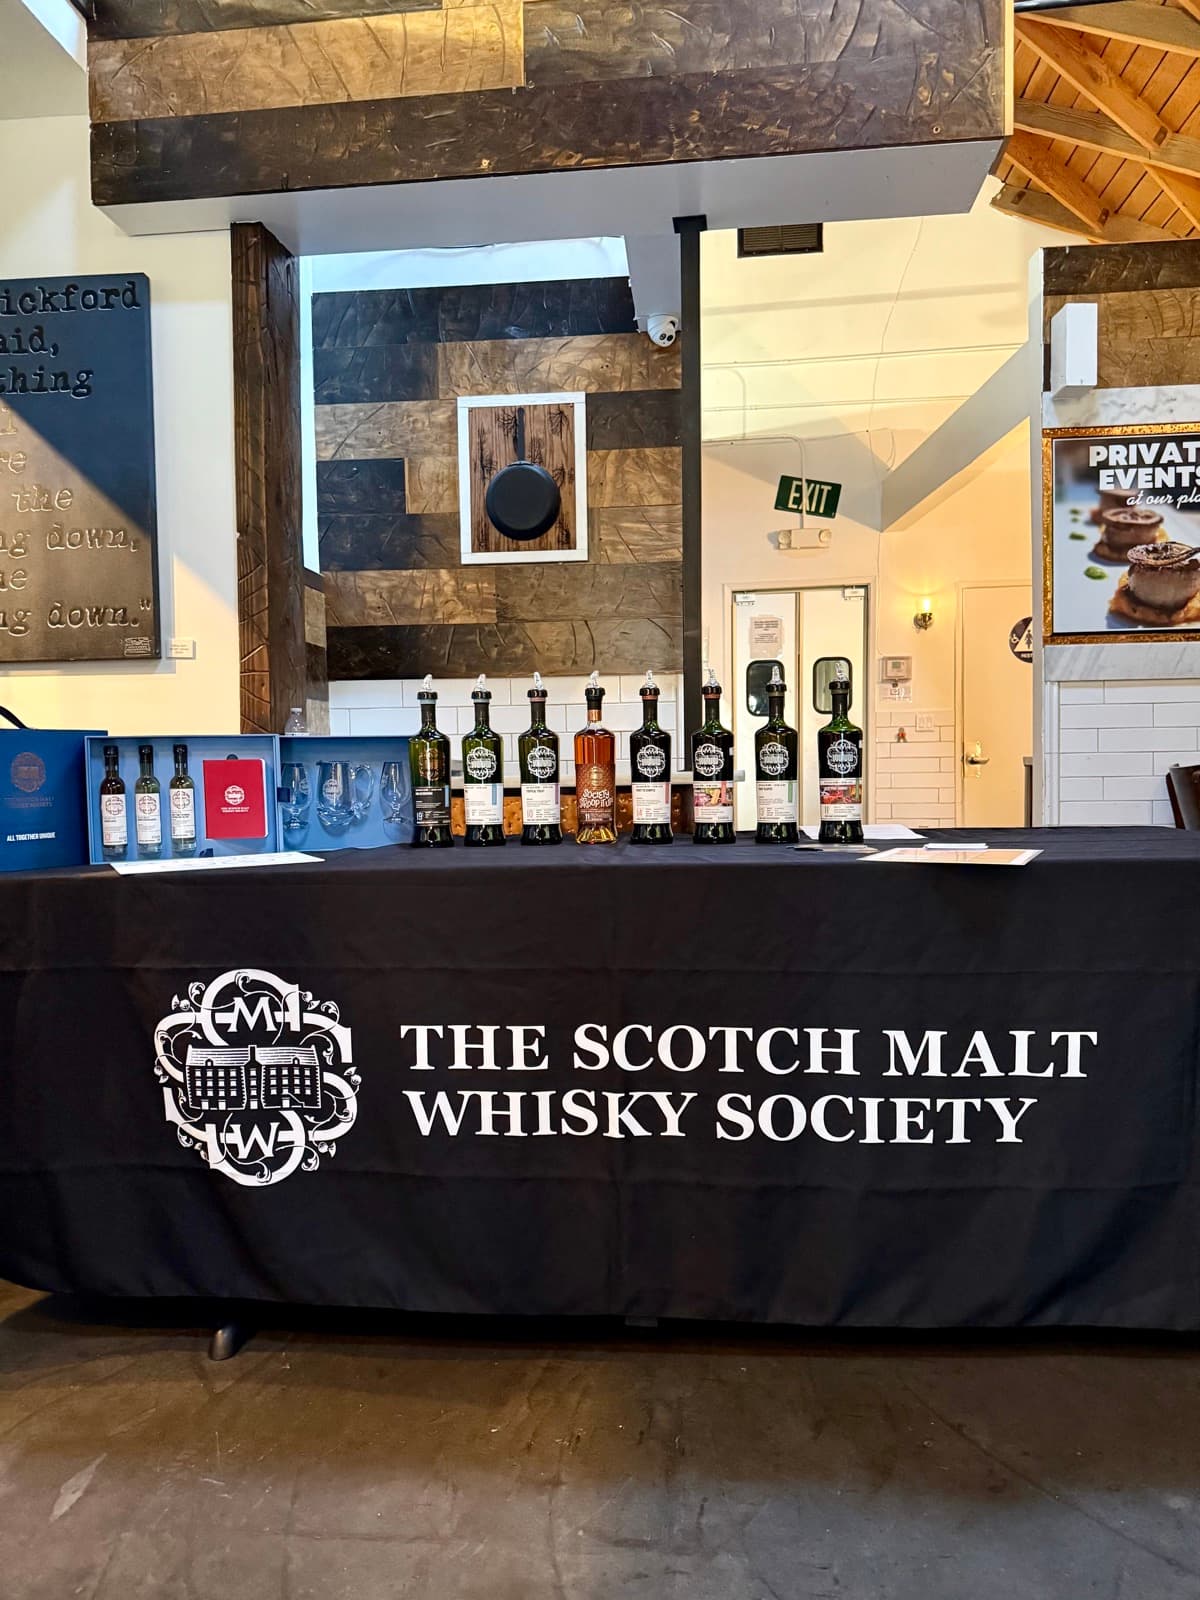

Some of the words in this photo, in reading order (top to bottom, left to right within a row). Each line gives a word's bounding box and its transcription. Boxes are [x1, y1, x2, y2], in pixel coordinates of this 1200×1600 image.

[1088, 441, 1200, 467] PRIVAT
[12, 485, 73, 513] the
[788, 480, 832, 513] EXIT
[1126, 490, 1144, 506] at
[1146, 494, 1174, 505] our
[46, 524, 138, 553] down,
[583, 789, 610, 799] SOCIETY
[7, 834, 16, 842] ALL
[400, 1024, 549, 1071] THE
[573, 1023, 861, 1075] SCOTCH
[881, 1028, 1098, 1078] MALT
[402, 1089, 698, 1138] WHISKY
[716, 1092, 1038, 1144] SOCIETY
